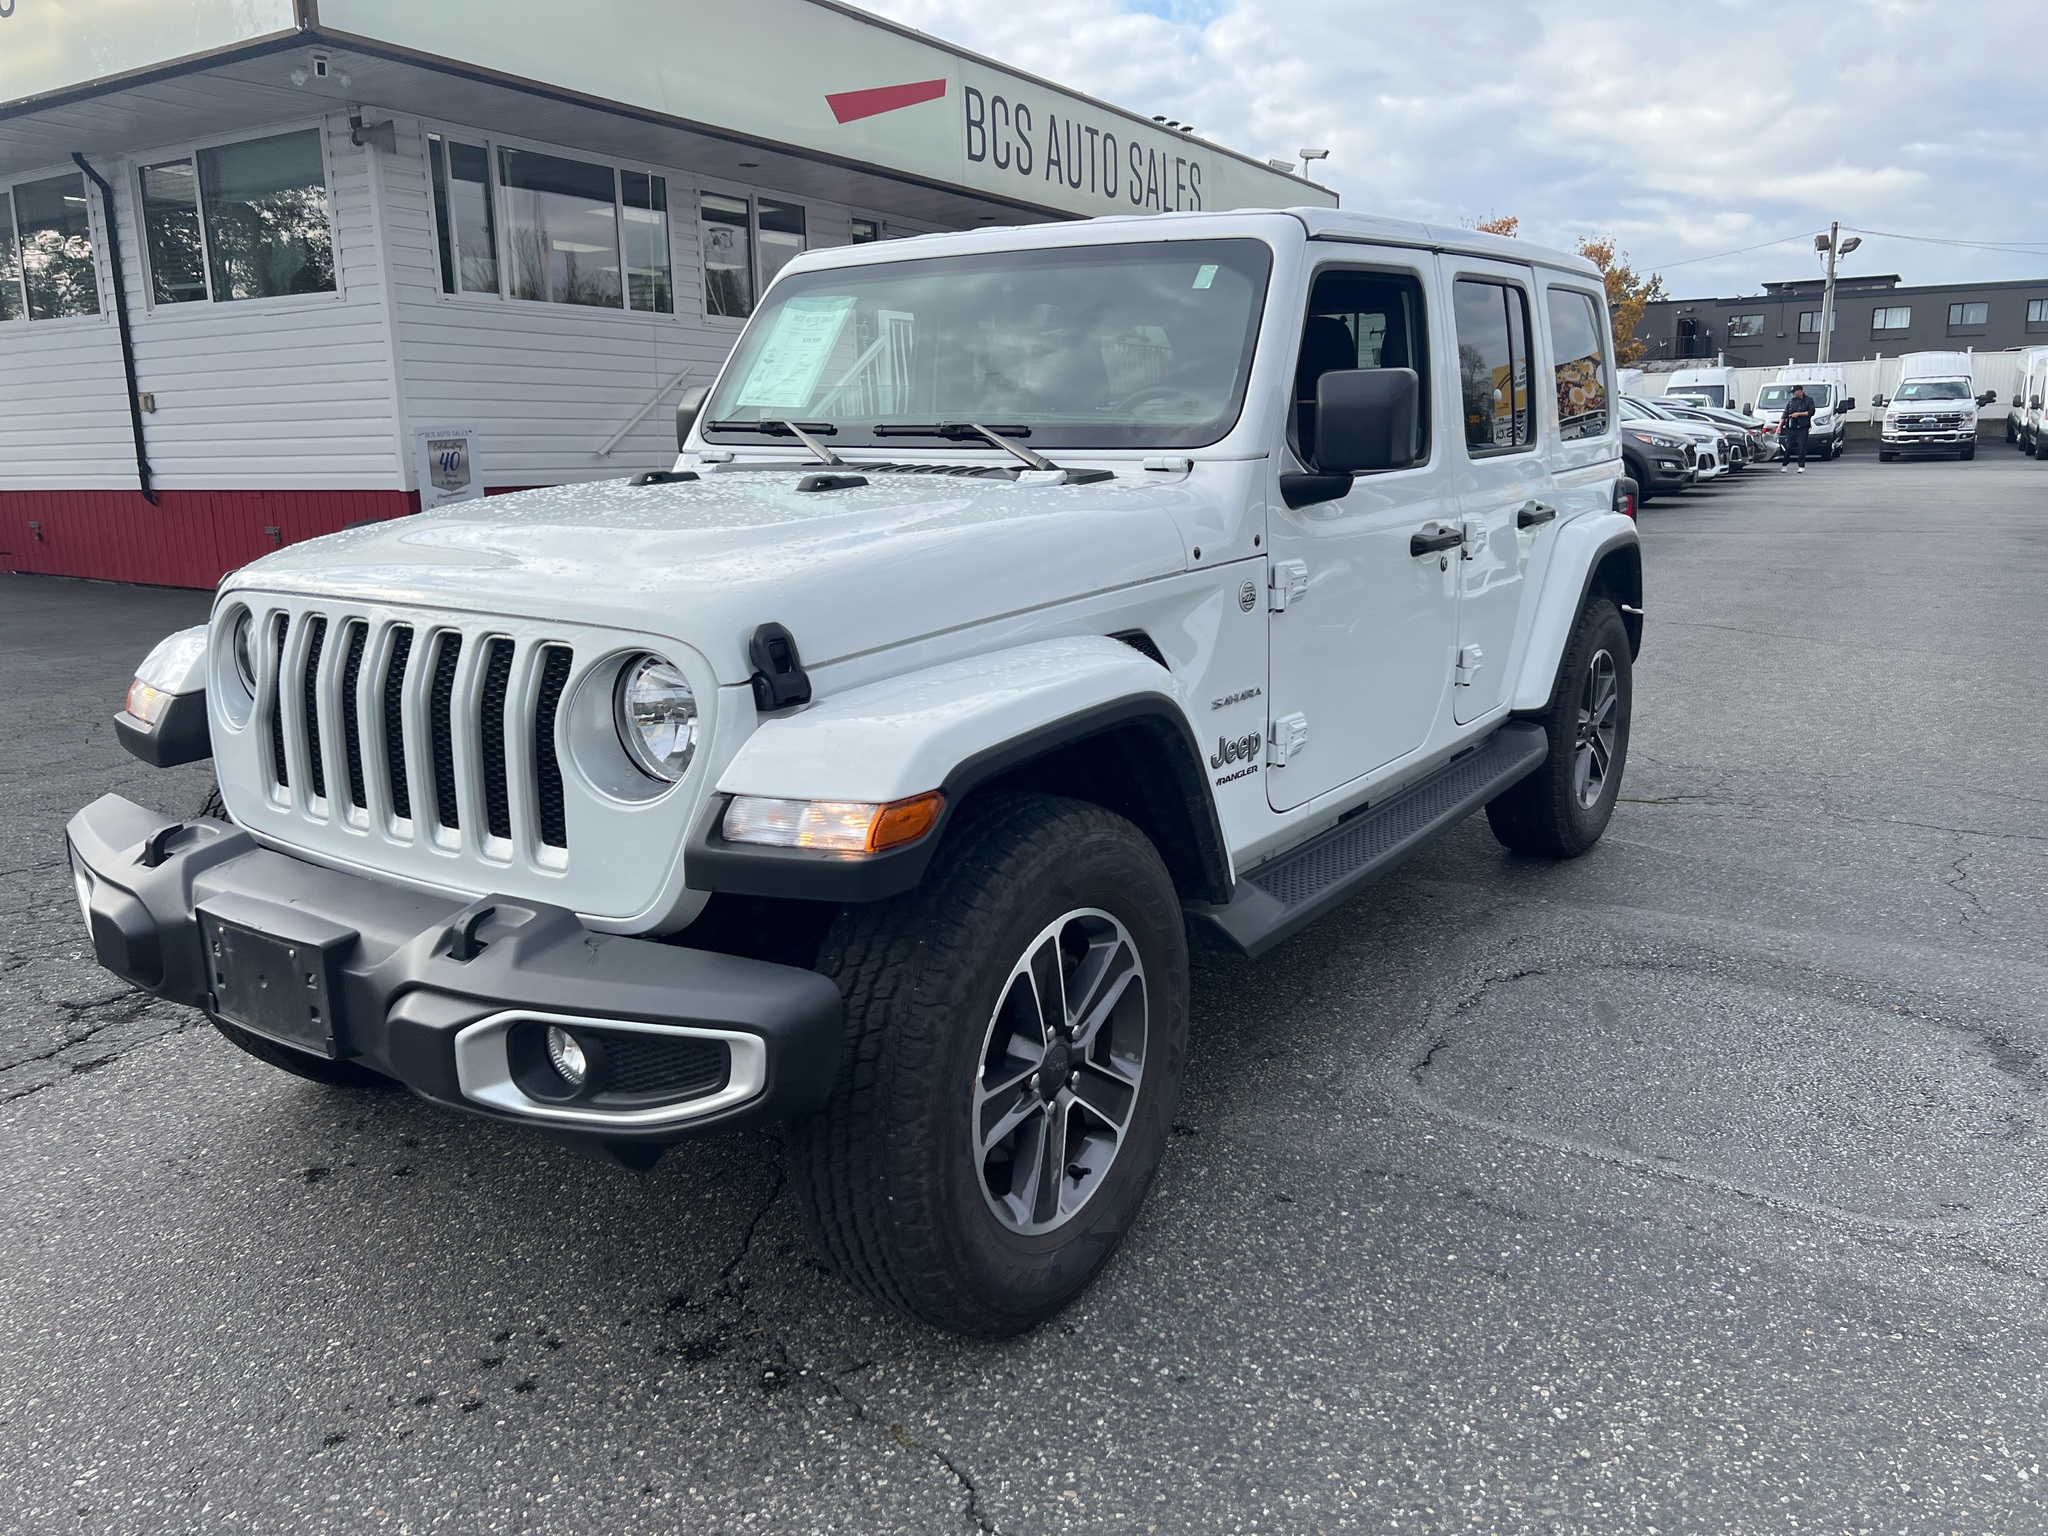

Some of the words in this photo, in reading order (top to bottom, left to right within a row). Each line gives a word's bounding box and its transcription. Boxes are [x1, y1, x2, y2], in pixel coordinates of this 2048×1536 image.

[964, 86, 1033, 175] BCS
[1045, 114, 1118, 198] AUTO
[1129, 141, 1201, 211] SALES
[793, 314, 806, 322] BCS
[807, 315, 820, 323] AUTO
[821, 314, 837, 323] SALES
[440, 451, 460, 472] 40
[1211, 687, 1262, 710] SAHARA
[1211, 731, 1261, 769] Jeep
